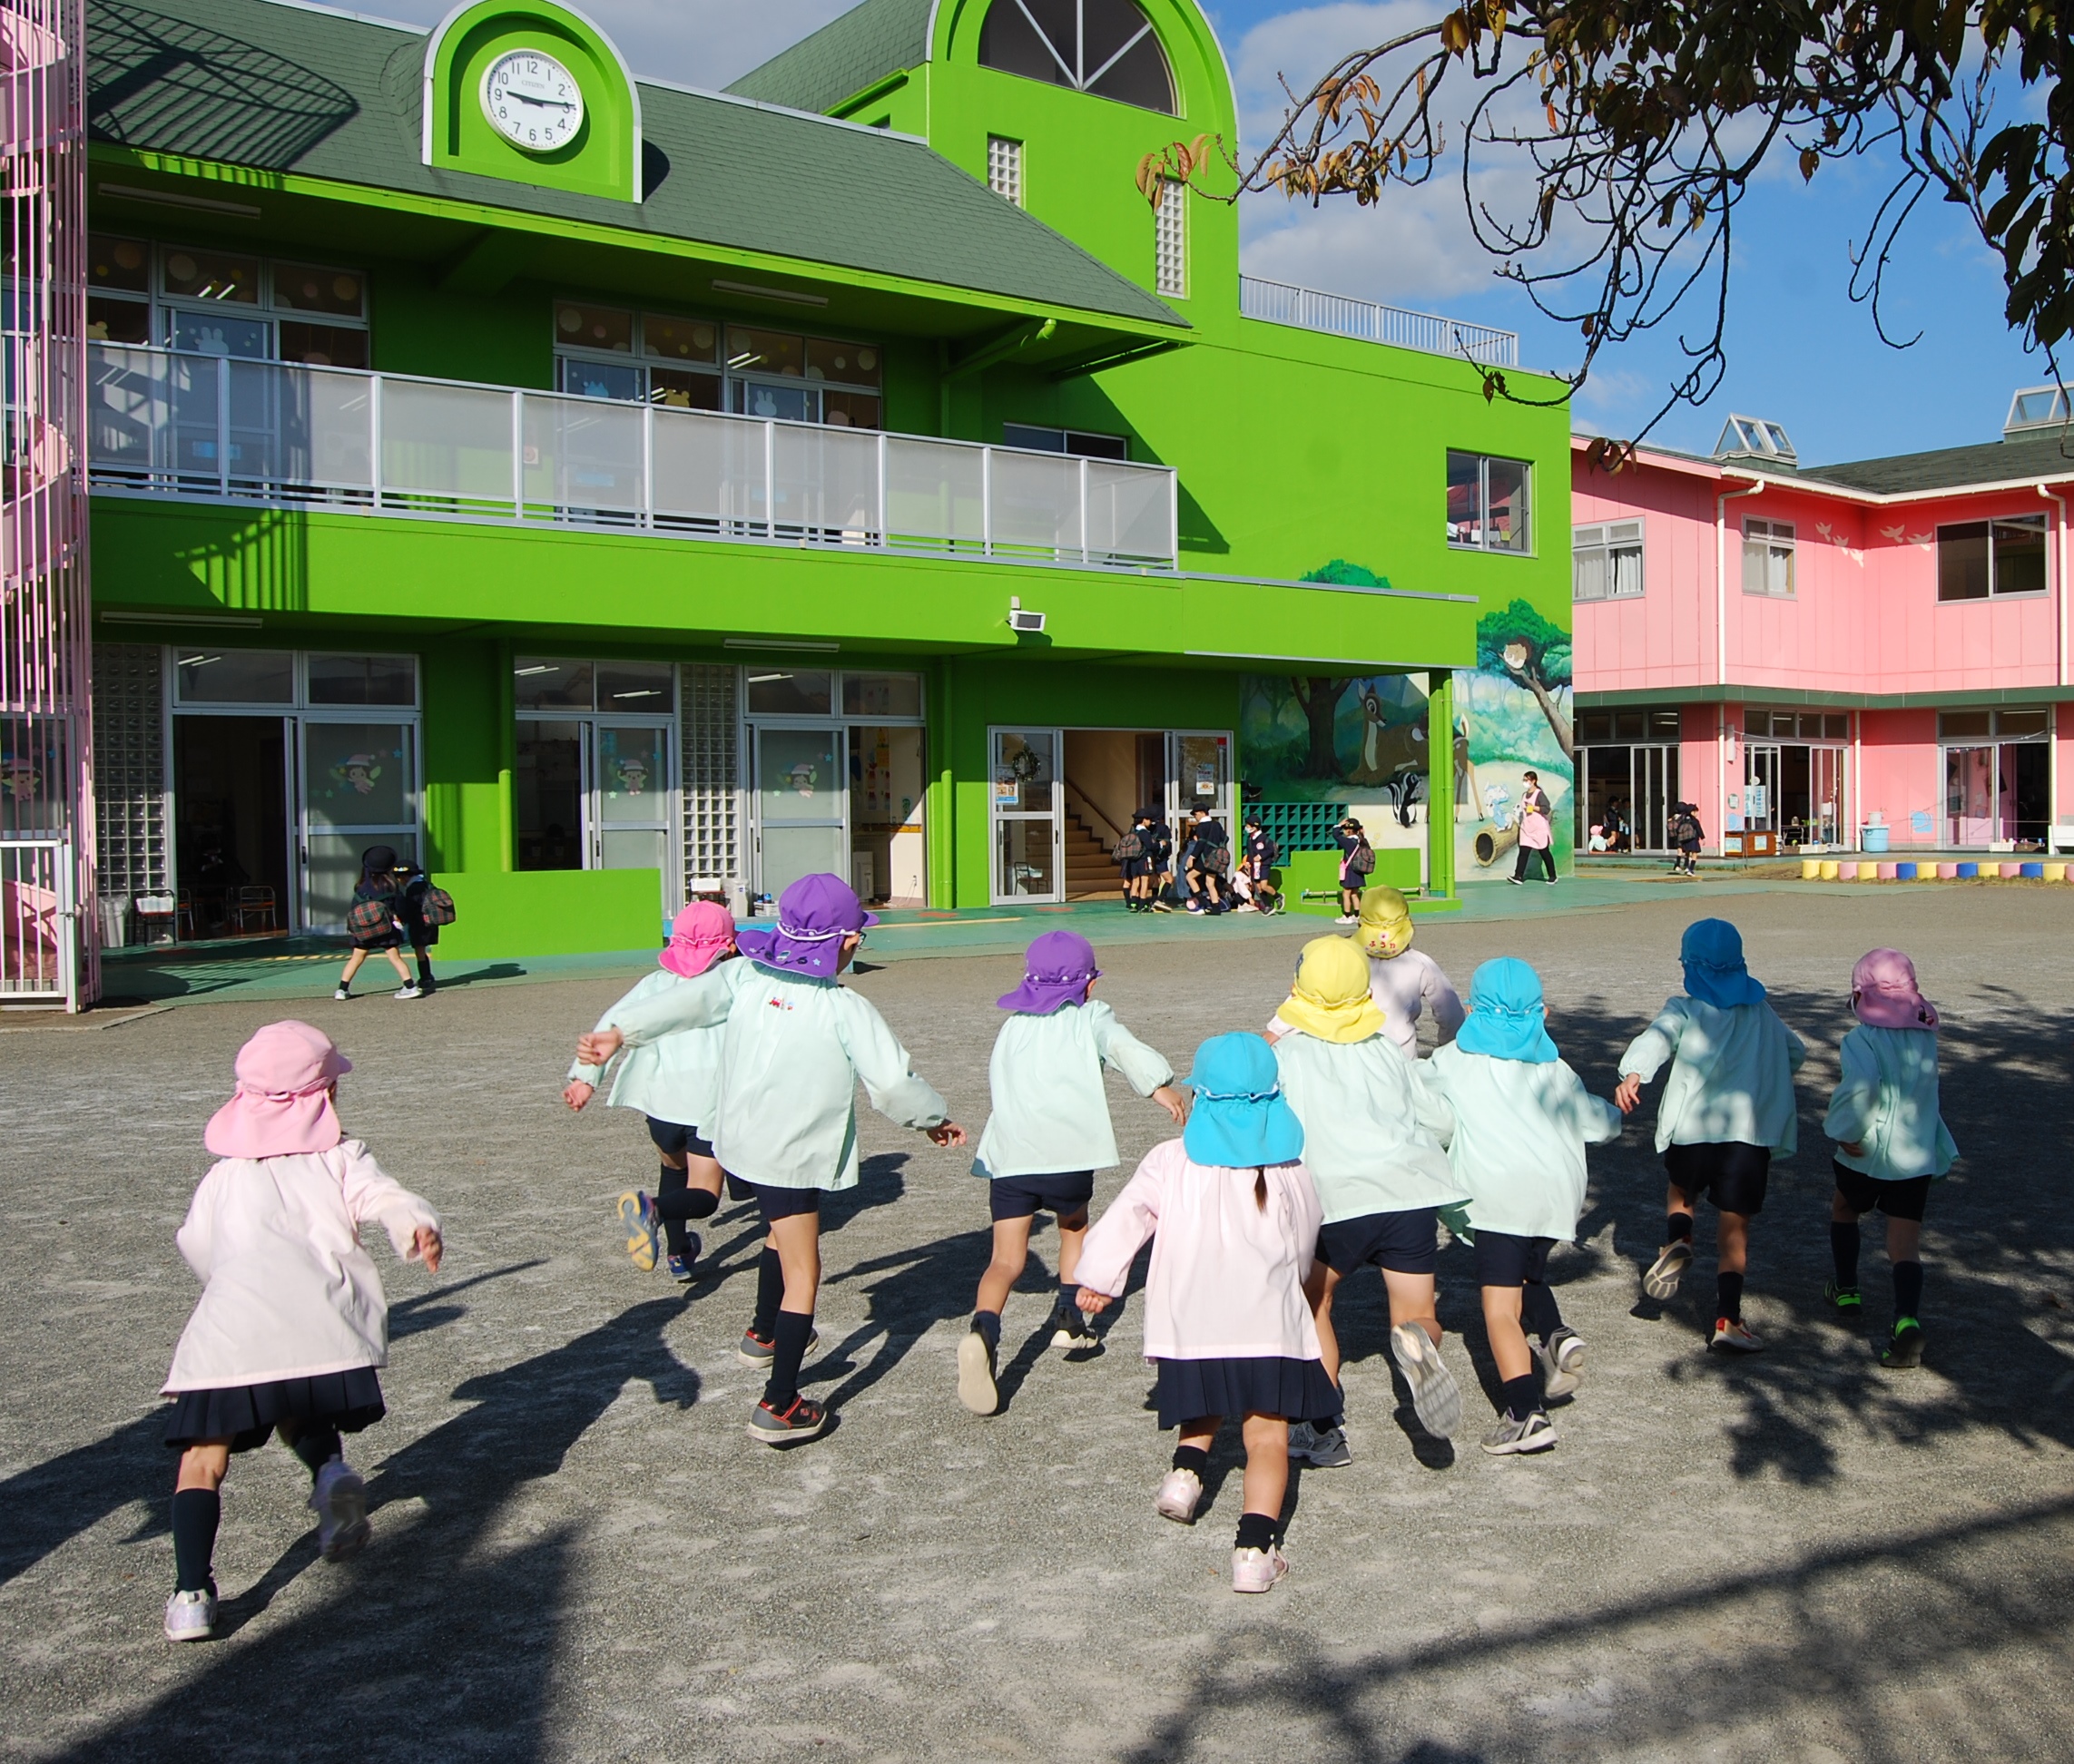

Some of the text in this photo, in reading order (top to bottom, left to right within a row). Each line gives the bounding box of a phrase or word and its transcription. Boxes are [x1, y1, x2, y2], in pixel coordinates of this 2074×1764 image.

[512, 62, 520, 75] 11
[526, 60, 538, 74] 12
[497, 71, 509, 85] 10
[547, 69, 550, 81] 1
[521, 80, 545, 89] CITIZEN
[558, 83, 565, 96] 2
[495, 88, 502, 101] 9
[498, 106, 507, 119] 8
[513, 122, 521, 134] 7
[557, 118, 565, 130] 4
[529, 129, 536, 141] 6
[545, 128, 552, 140] 5
